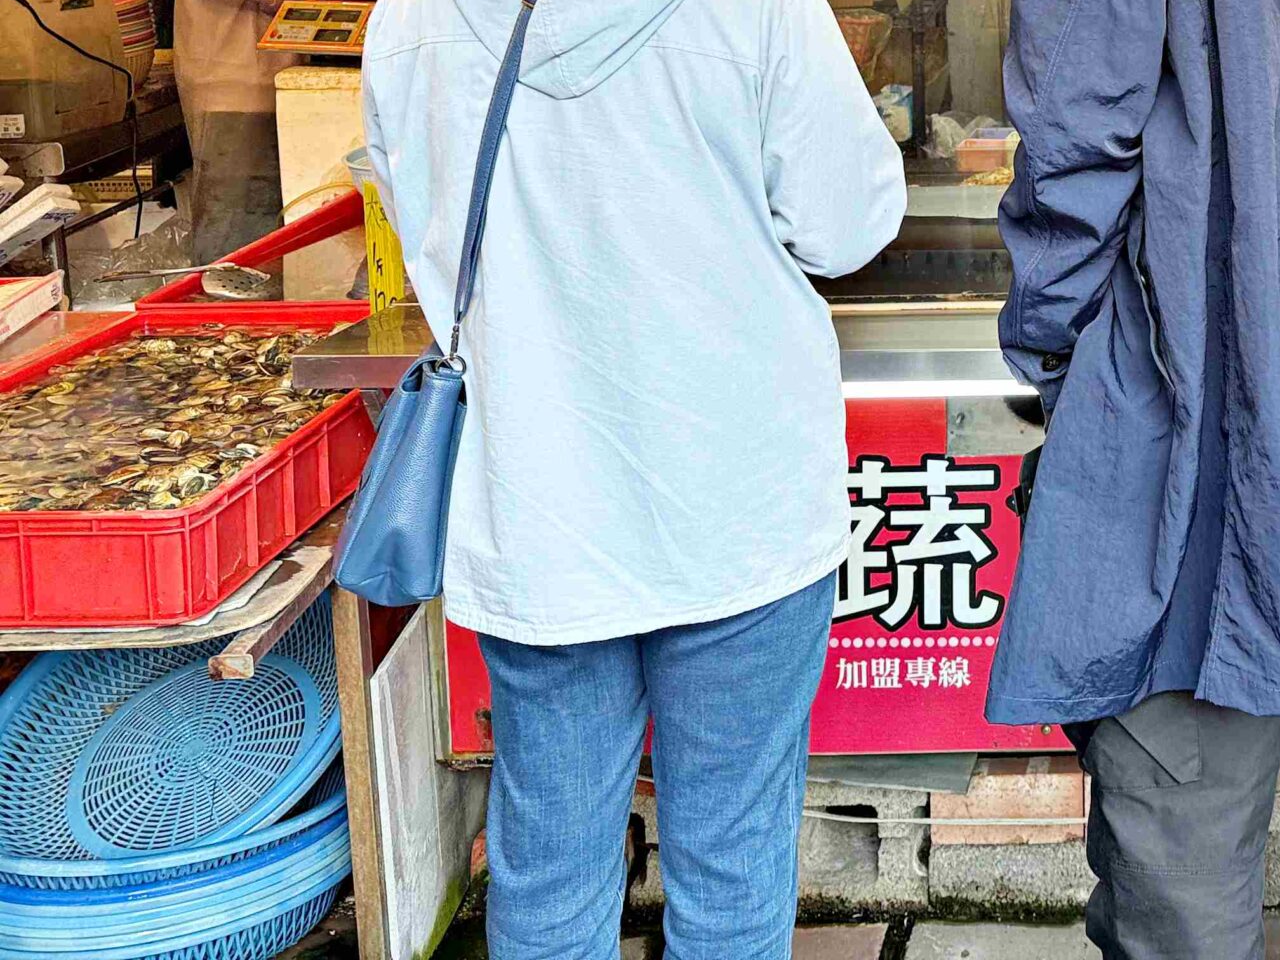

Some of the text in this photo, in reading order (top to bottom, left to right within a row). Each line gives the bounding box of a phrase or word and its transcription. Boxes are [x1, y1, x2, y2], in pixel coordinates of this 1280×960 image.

[832, 453, 1006, 632] 蔬
[835, 656, 973, 690] 加盟專線
